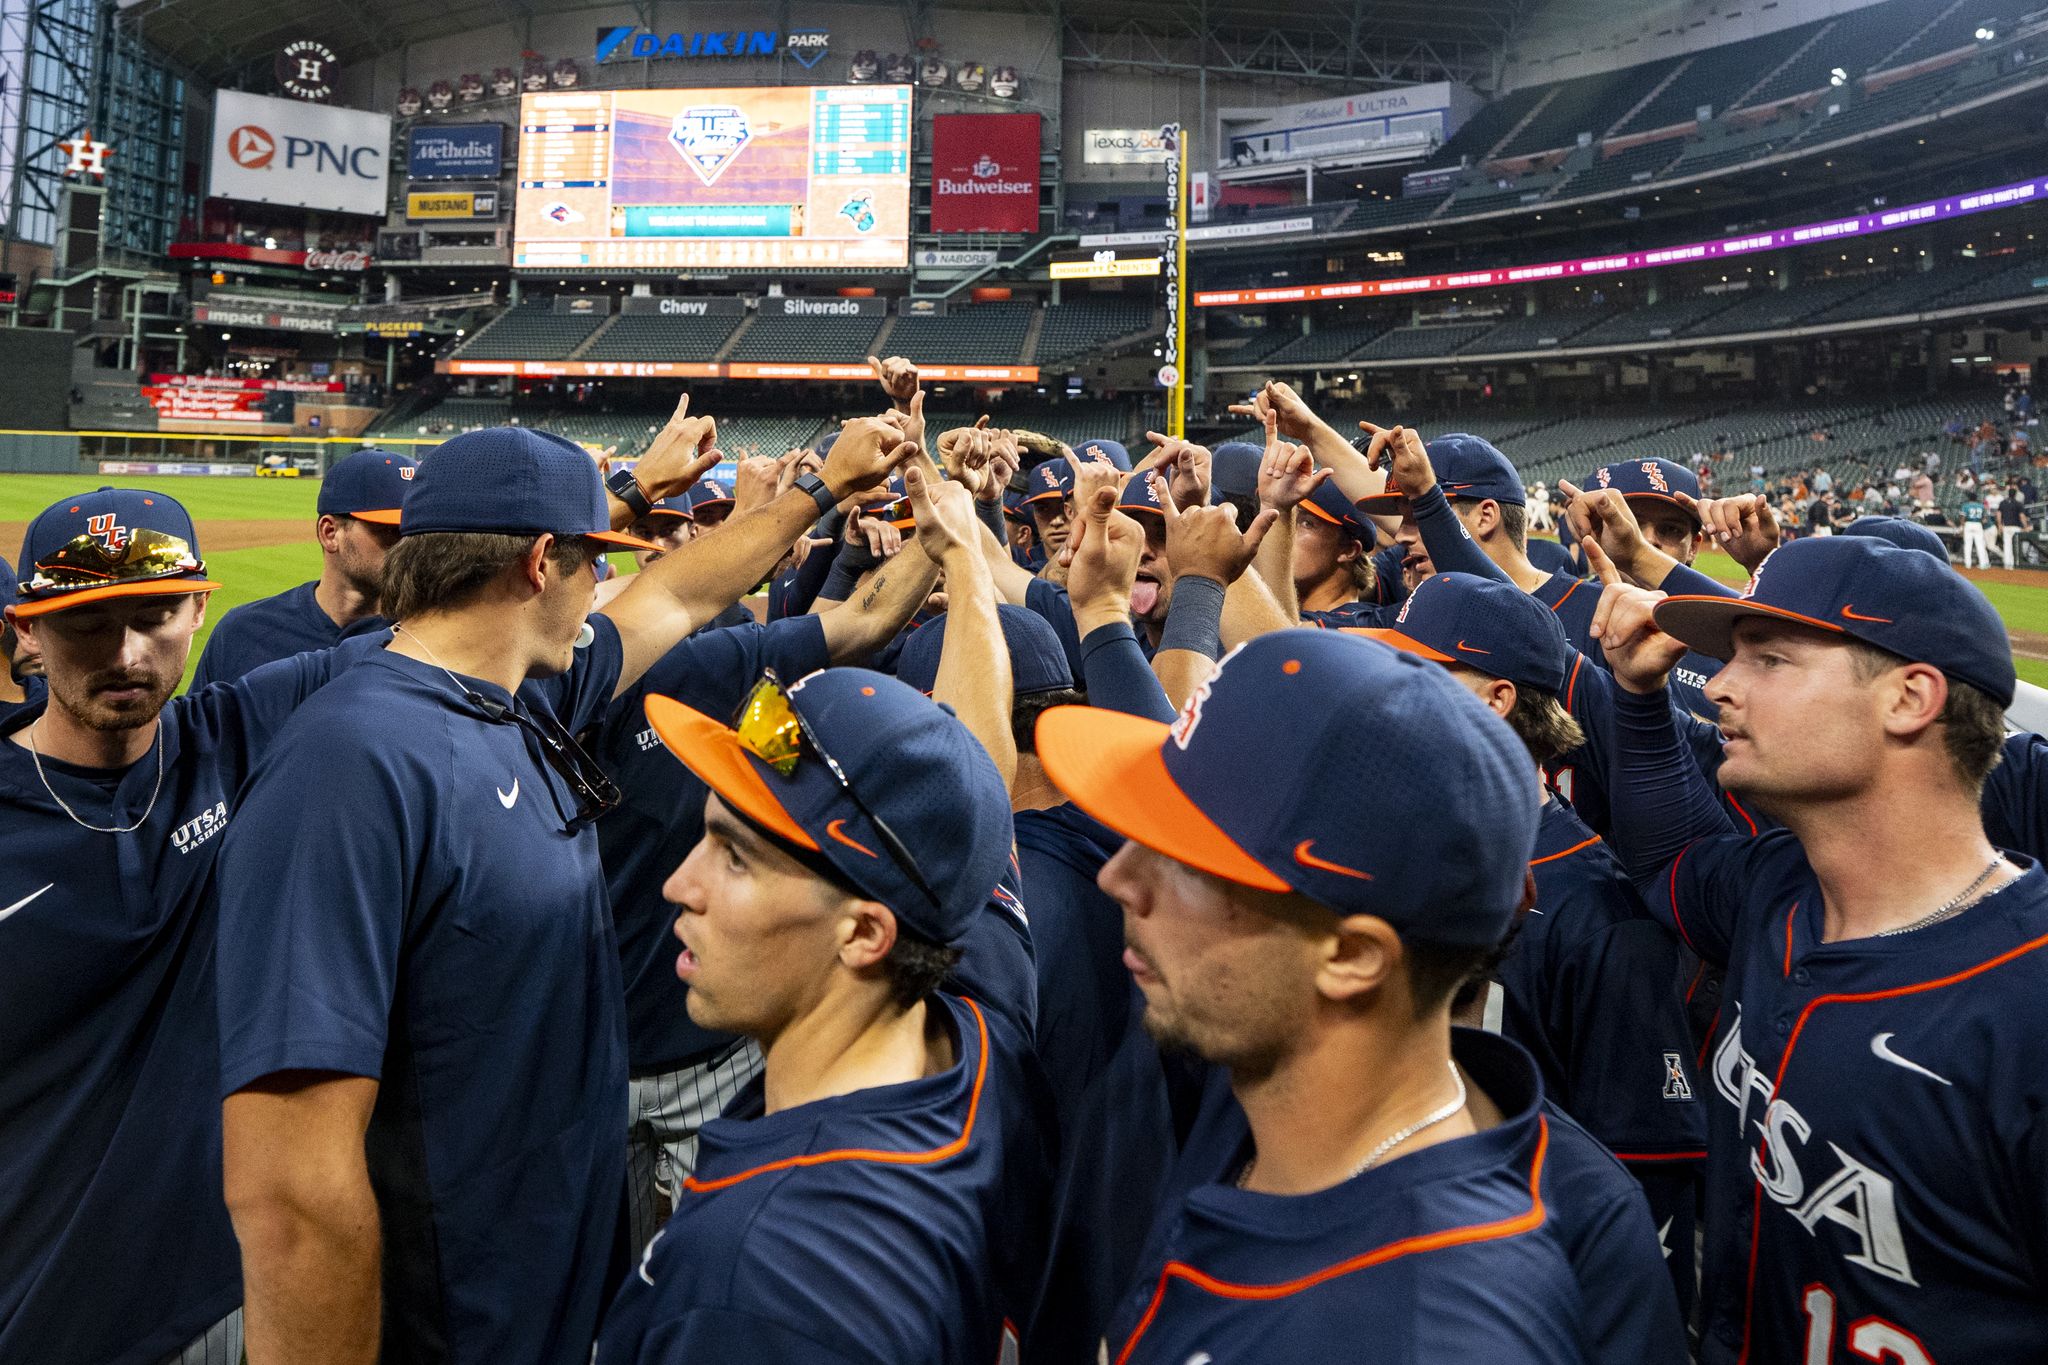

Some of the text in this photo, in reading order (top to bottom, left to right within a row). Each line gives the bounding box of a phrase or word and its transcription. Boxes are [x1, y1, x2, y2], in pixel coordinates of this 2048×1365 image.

[632, 31, 777, 57] DAIKIN
[788, 34, 829, 47] PARK
[284, 41, 336, 63] HOUSTON
[298, 58, 322, 81] H
[964, 61, 977, 79] 7
[284, 80, 331, 98] ASTROS
[1358, 96, 1409, 113] ULTRA
[1091, 131, 1162, 149] Texas Ba
[66, 139, 108, 174] H
[283, 136, 380, 180] PNC
[416, 141, 494, 160] Methodist
[418, 198, 494, 212] MUSTANG CAT
[939, 252, 988, 265] NABORS
[1165, 158, 1179, 364] ROOT 4 THA CHIKIN
[660, 300, 707, 316] Chevy
[784, 299, 860, 315] Silverado
[207, 310, 264, 327] impact
[280, 316, 334, 333] impact
[365, 321, 424, 332] PLUCKERS
[1676, 667, 1708, 685] UTS
[1677, 676, 1705, 690] BASEB
[635, 728, 659, 746] UT
[170, 801, 228, 847] UTSA
[180, 817, 228, 855] BASEBALL
